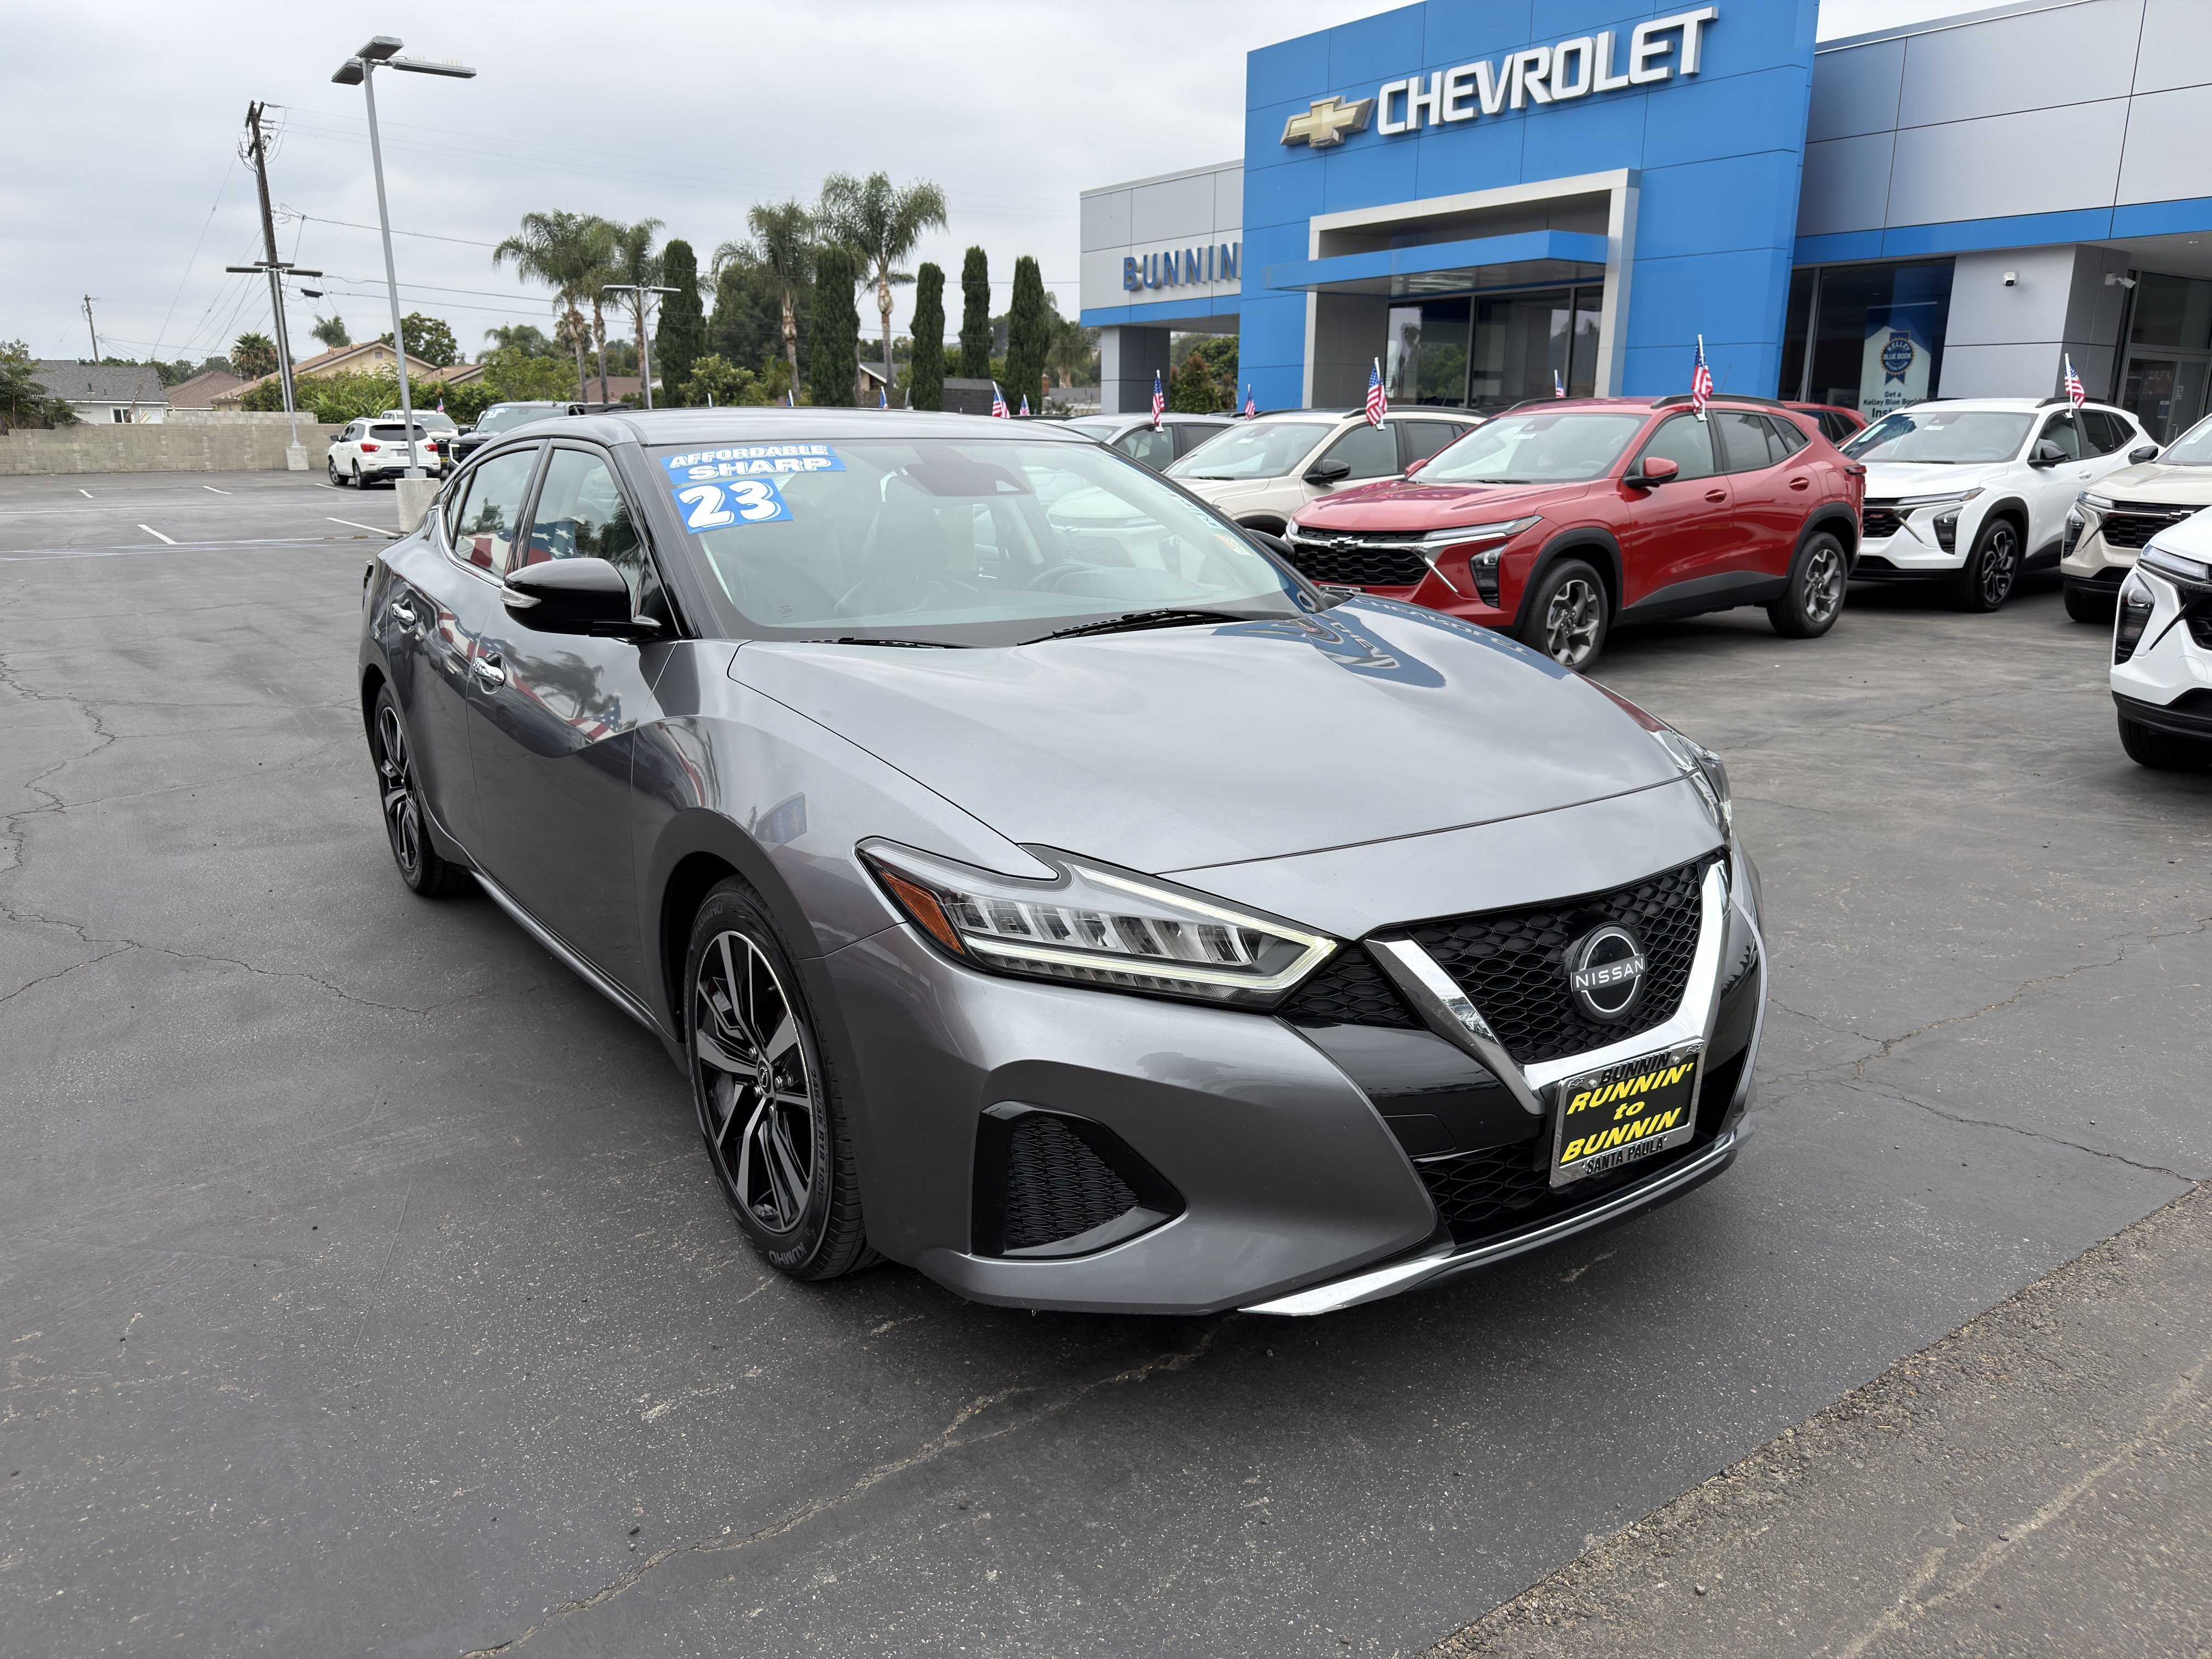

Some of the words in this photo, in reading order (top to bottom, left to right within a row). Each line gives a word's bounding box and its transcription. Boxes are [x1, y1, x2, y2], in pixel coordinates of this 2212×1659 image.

[1377, 7, 1719, 136] CHEVROLET
[1123, 242, 1242, 290] BUNNIN
[1887, 341, 1911, 352] KELLEY
[669, 444, 829, 469] AFFORDABLE
[688, 457, 832, 480] SHARP
[678, 480, 781, 528] 23
[1575, 957, 1644, 988] NISSAN
[1599, 1050, 1672, 1086] BUNNIN
[810, 1068, 823, 1125] 245/45
[1566, 1062, 1695, 1115] RUNNIN'
[1613, 1101, 1645, 1120] to
[1560, 1107, 1681, 1163] BUNNIN
[1585, 1148, 1623, 1175] SANTA
[1627, 1135, 1663, 1161] PAULA
[769, 1242, 807, 1265] KUMHO
